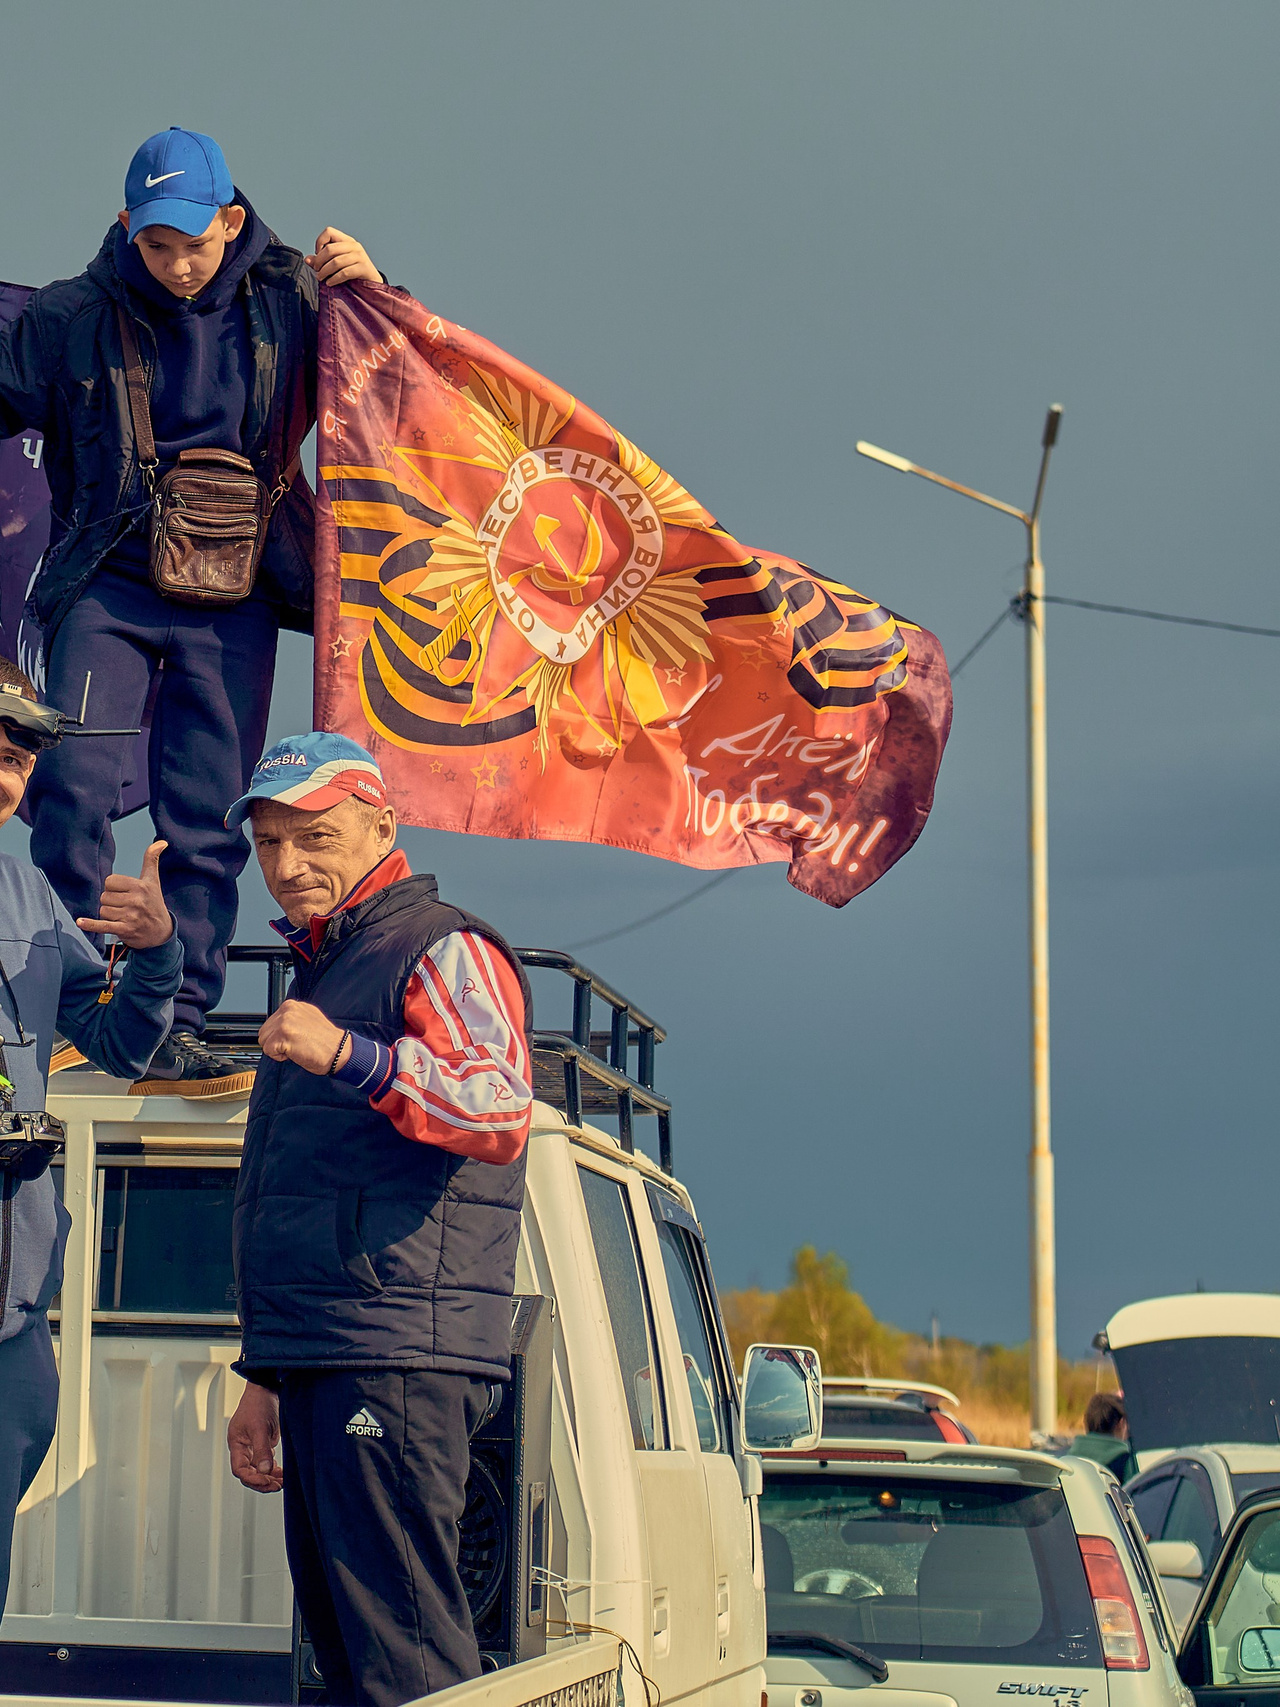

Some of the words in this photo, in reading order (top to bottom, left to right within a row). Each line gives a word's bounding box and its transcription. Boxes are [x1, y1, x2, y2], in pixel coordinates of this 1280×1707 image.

[323, 409, 348, 440] Я
[425, 314, 448, 344] Я
[574, 546, 659, 649] ВОЙНА
[357, 780, 381, 799] RUSSIA
[345, 1424, 383, 1438] SPORTS
[996, 1681, 1090, 1699] SWIFT
